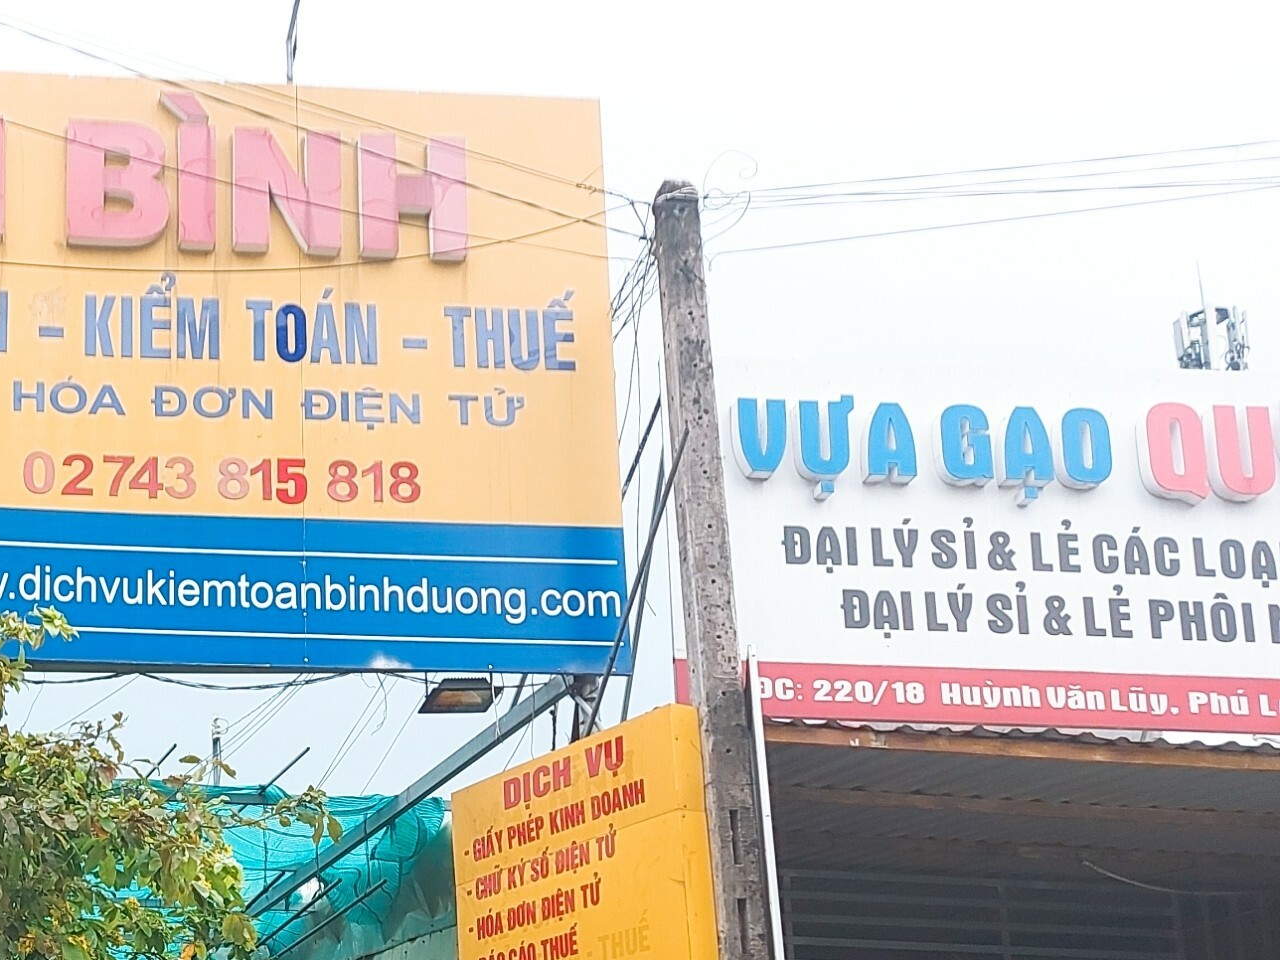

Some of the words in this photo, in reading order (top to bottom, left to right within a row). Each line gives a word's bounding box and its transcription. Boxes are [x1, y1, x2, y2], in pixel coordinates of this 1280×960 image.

[67, 90, 469, 264] BÌNH
[83, 272, 220, 359] KIỂM
[245, 288, 378, 366] TOÁN
[444, 290, 577, 371] THUẾ
[14, 375, 127, 416] HÓA
[151, 385, 274, 420] ĐƠN
[301, 388, 421, 430] ĐIỆN
[448, 387, 524, 427] TỬ
[22, 451, 196, 500] 02743
[218, 456, 308, 505] 815
[326, 460, 421, 505] 818
[734, 395, 918, 500] VỰA
[934, 403, 1114, 507] GẠO
[781, 525, 858, 573] ĐẠI
[871, 518, 919, 568] LÝ
[930, 517, 977, 570] SỈ
[987, 531, 1018, 571] &
[1030, 518, 1082, 573] LẺ
[1092, 526, 1180, 577] CÁC
[1192, 537, 1280, 588] LOẠ
[840, 589, 914, 639] ĐẠI
[925, 583, 973, 632] LÝ
[986, 581, 1030, 635] SỈ
[1043, 595, 1073, 636] &
[1083, 584, 1133, 638] LẺ
[1148, 593, 1256, 643] PHÔI
[812, 679, 926, 706] 220/18
[940, 680, 1040, 709] Huỳnh
[1046, 684, 1106, 711] Văn
[1188, 689, 1251, 716] Phú
[503, 755, 572, 811] DỊCH
[584, 735, 624, 778] VỤ
[472, 825, 503, 862] GIẤY
[507, 813, 545, 850] PHÉP
[548, 800, 586, 835] KINH
[590, 778, 646, 821] DOANH
[475, 865, 503, 901] CHỮ
[507, 858, 527, 891] KÝ
[530, 846, 550, 883] SỐ
[555, 840, 590, 875] ĐIỆN
[595, 823, 617, 861] TỬ
[476, 908, 504, 941] HÓA
[507, 900, 537, 931] ĐƠN
[541, 888, 576, 922] ĐIỆN
[580, 871, 602, 908] TỬ
